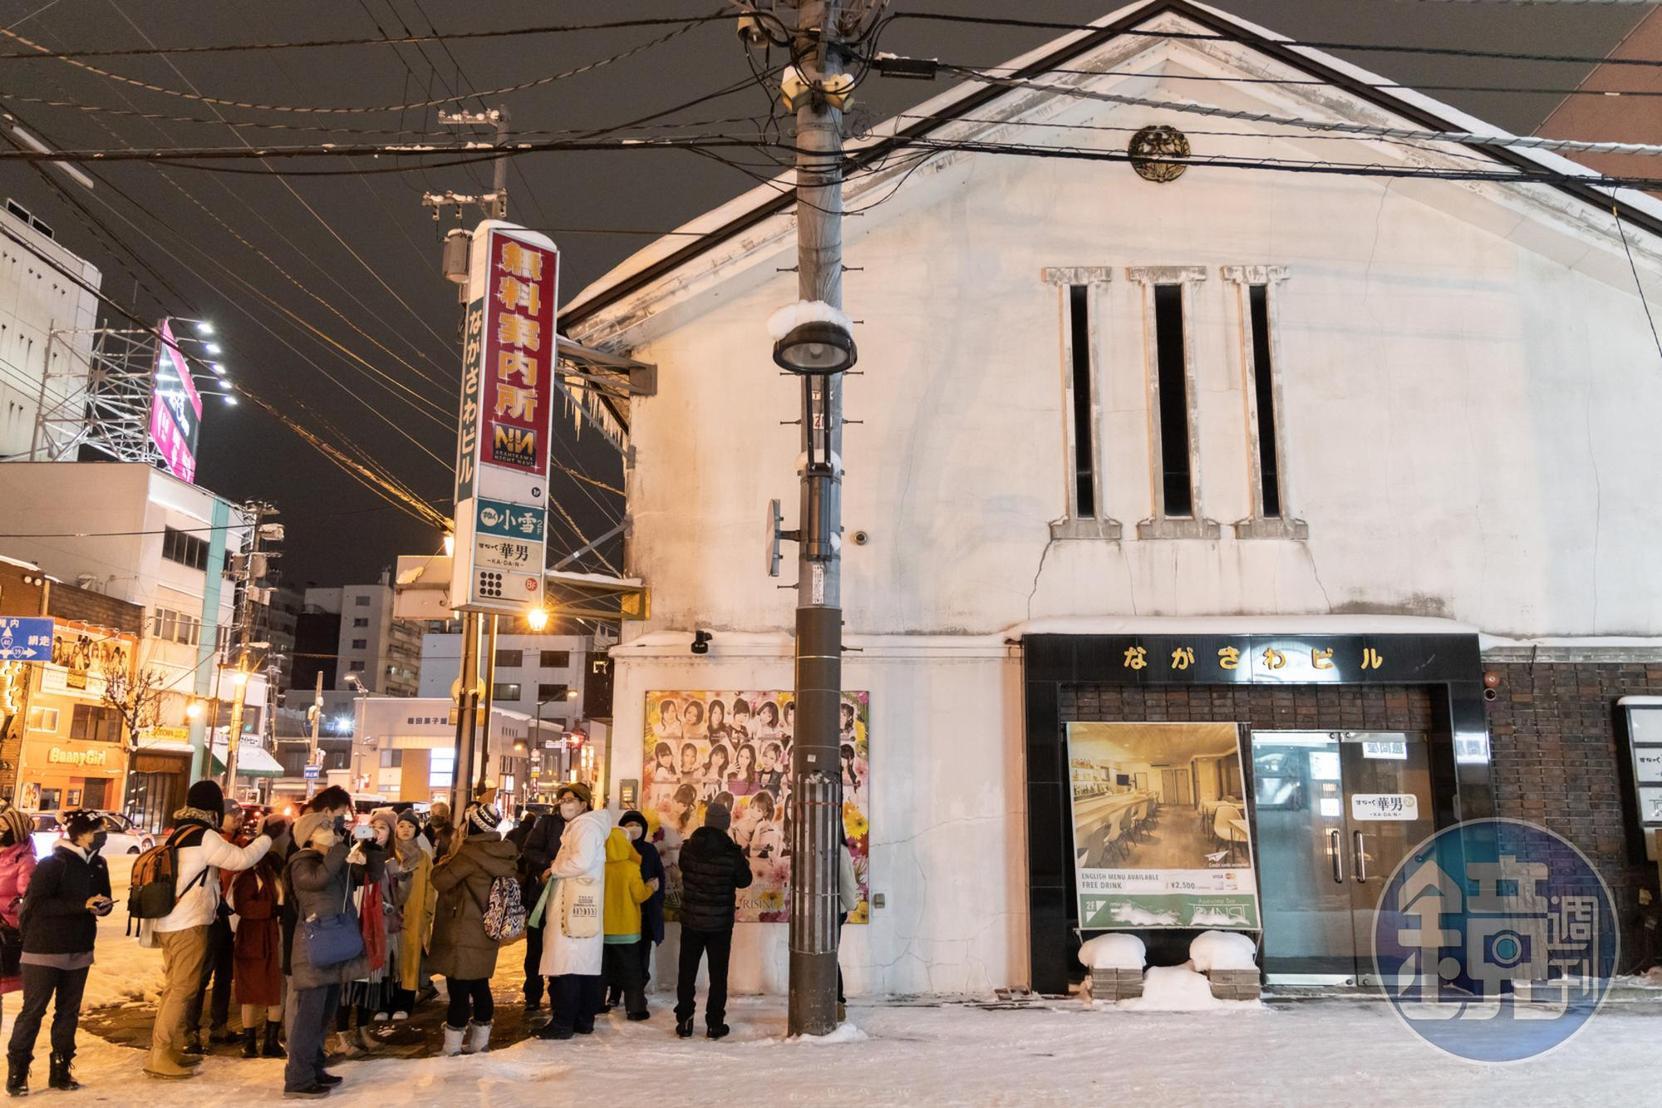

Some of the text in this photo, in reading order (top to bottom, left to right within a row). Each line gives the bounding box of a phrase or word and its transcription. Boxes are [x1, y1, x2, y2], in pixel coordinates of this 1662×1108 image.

[495, 241, 543, 422] 無料案内所
[459, 310, 482, 484] ながさわビル
[498, 509, 537, 534] 小雪
[499, 542, 529, 561] 華男
[28, 637, 50, 648] 網走
[1123, 646, 1383, 671] ながさわビル
[1377, 797, 1403, 812] 華男
[1081, 873, 1107, 881] ENGLISH
[1108, 873, 1126, 881] MENU
